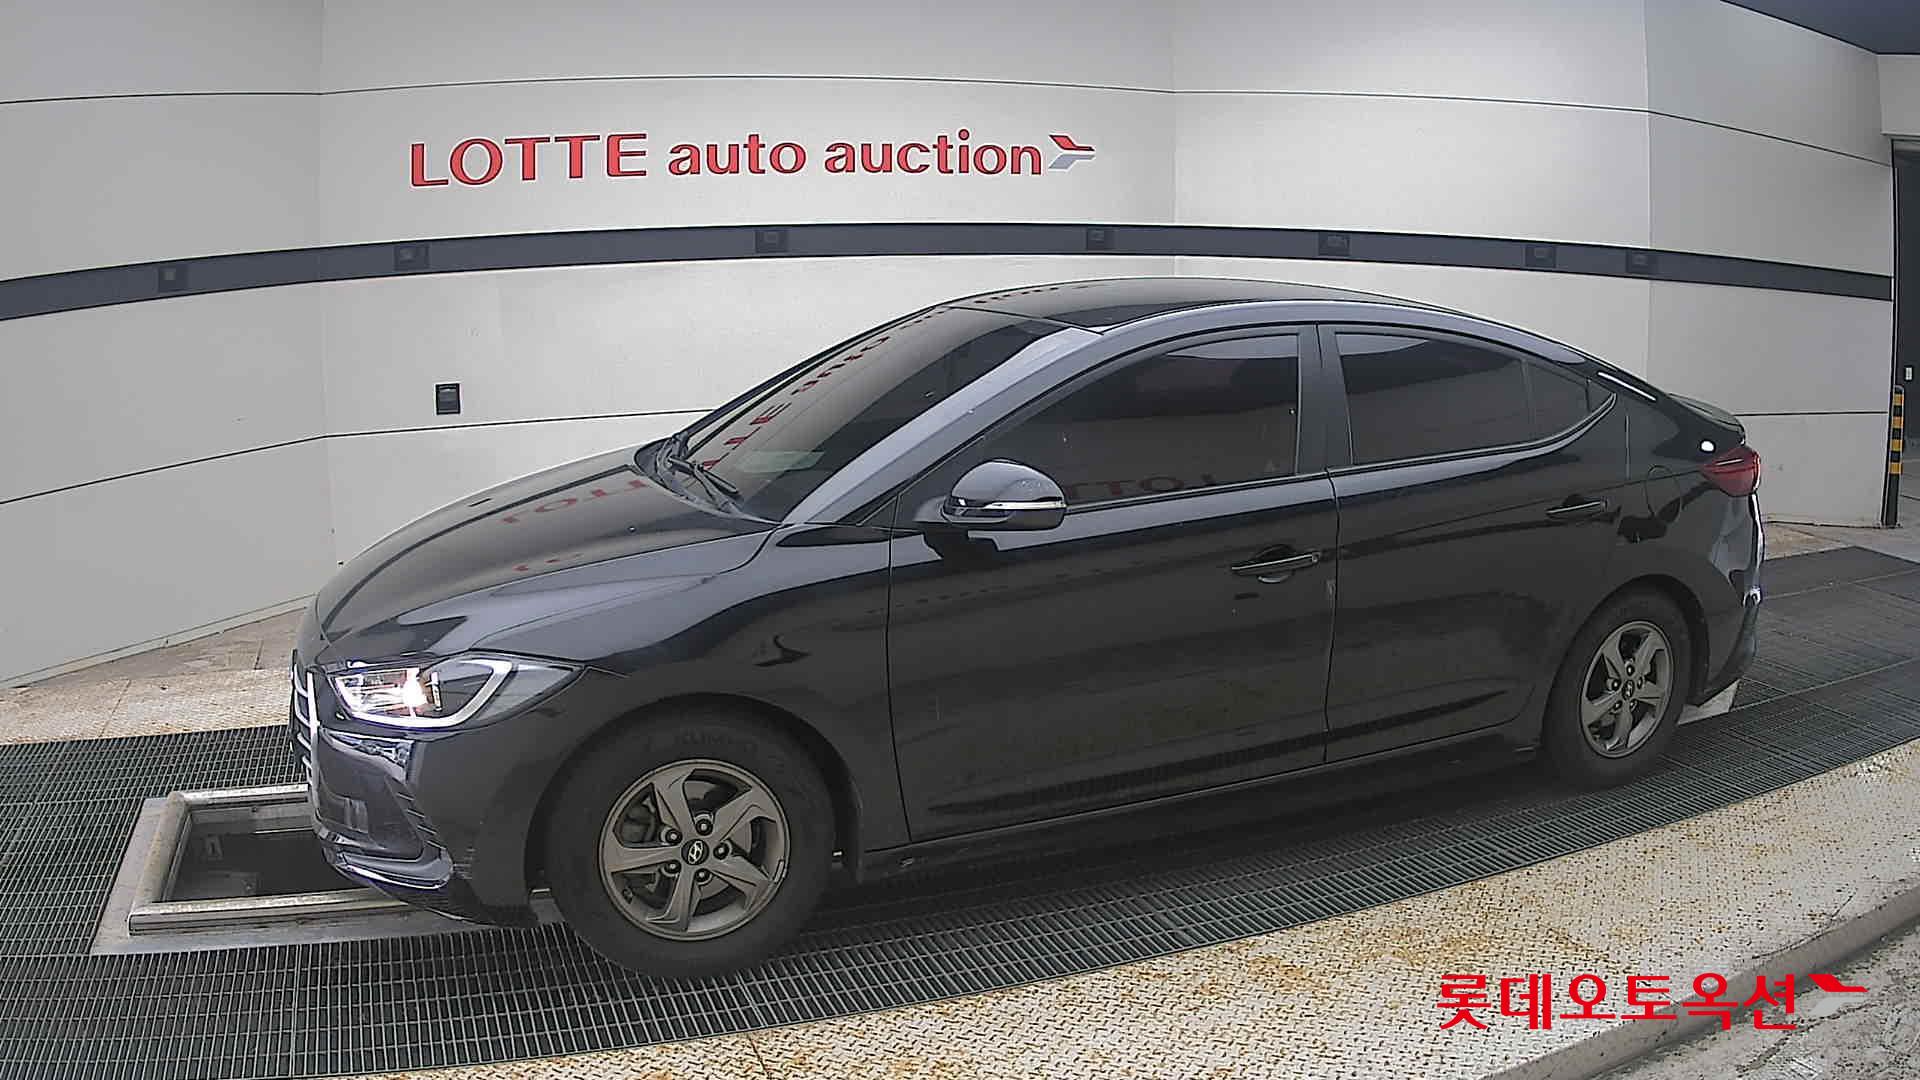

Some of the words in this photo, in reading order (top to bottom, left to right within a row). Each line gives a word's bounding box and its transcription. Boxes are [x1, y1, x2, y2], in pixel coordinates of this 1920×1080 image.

[410, 132, 647, 188] LOTTE
[668, 134, 808, 176] auto
[824, 128, 1042, 175] auction
